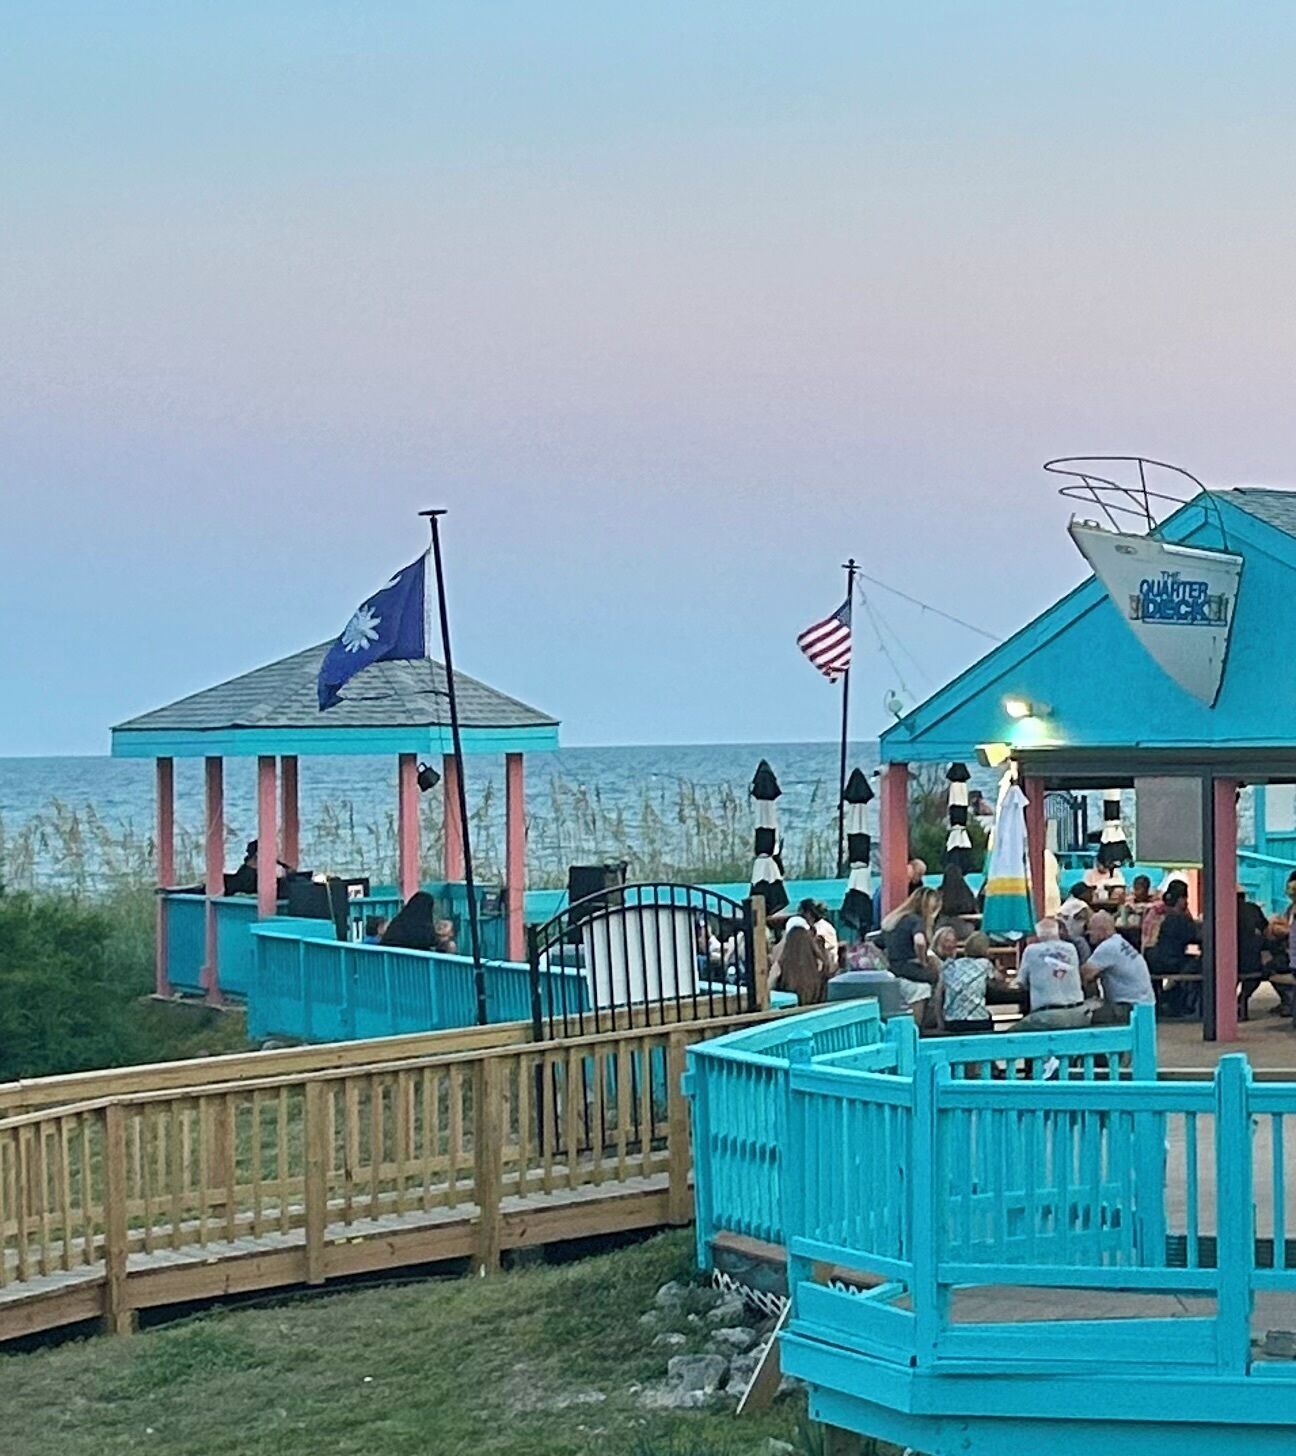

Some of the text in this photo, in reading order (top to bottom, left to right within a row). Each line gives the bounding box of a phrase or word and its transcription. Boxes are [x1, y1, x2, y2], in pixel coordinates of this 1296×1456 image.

[1160, 571, 1181, 581] THE
[1140, 579, 1209, 601] QUARTER
[1143, 599, 1210, 620] DECK
